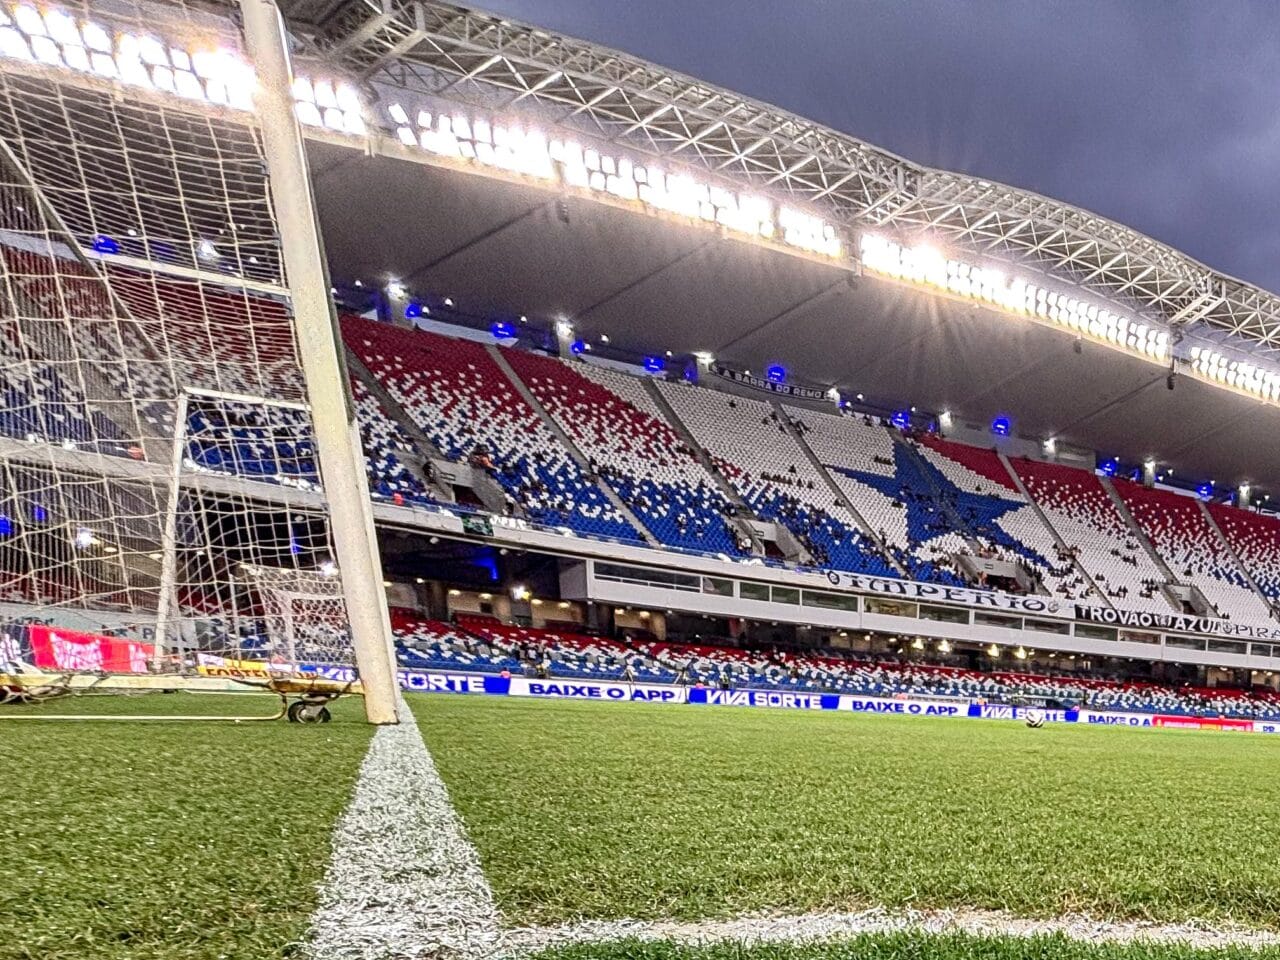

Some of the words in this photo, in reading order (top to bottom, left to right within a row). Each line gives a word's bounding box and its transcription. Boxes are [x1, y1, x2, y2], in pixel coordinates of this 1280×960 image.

[735, 373, 772, 390] BARRA
[776, 384, 791, 394] DO
[793, 387, 822, 398] REMO
[1174, 615, 1221, 634] AZUL
[529, 682, 599, 697] BAIXE
[606, 688, 625, 699] O
[634, 689, 675, 700] APP
[706, 689, 750, 705] VIVA
[754, 691, 821, 709] SORTE
[852, 700, 904, 713] BAIXE
[908, 704, 921, 714] O
[926, 706, 958, 715] APP
[979, 706, 1012, 719] VIVA
[1016, 709, 1065, 722] STE
[1089, 715, 1126, 725] BAIXE
[1130, 718, 1140, 726] O
